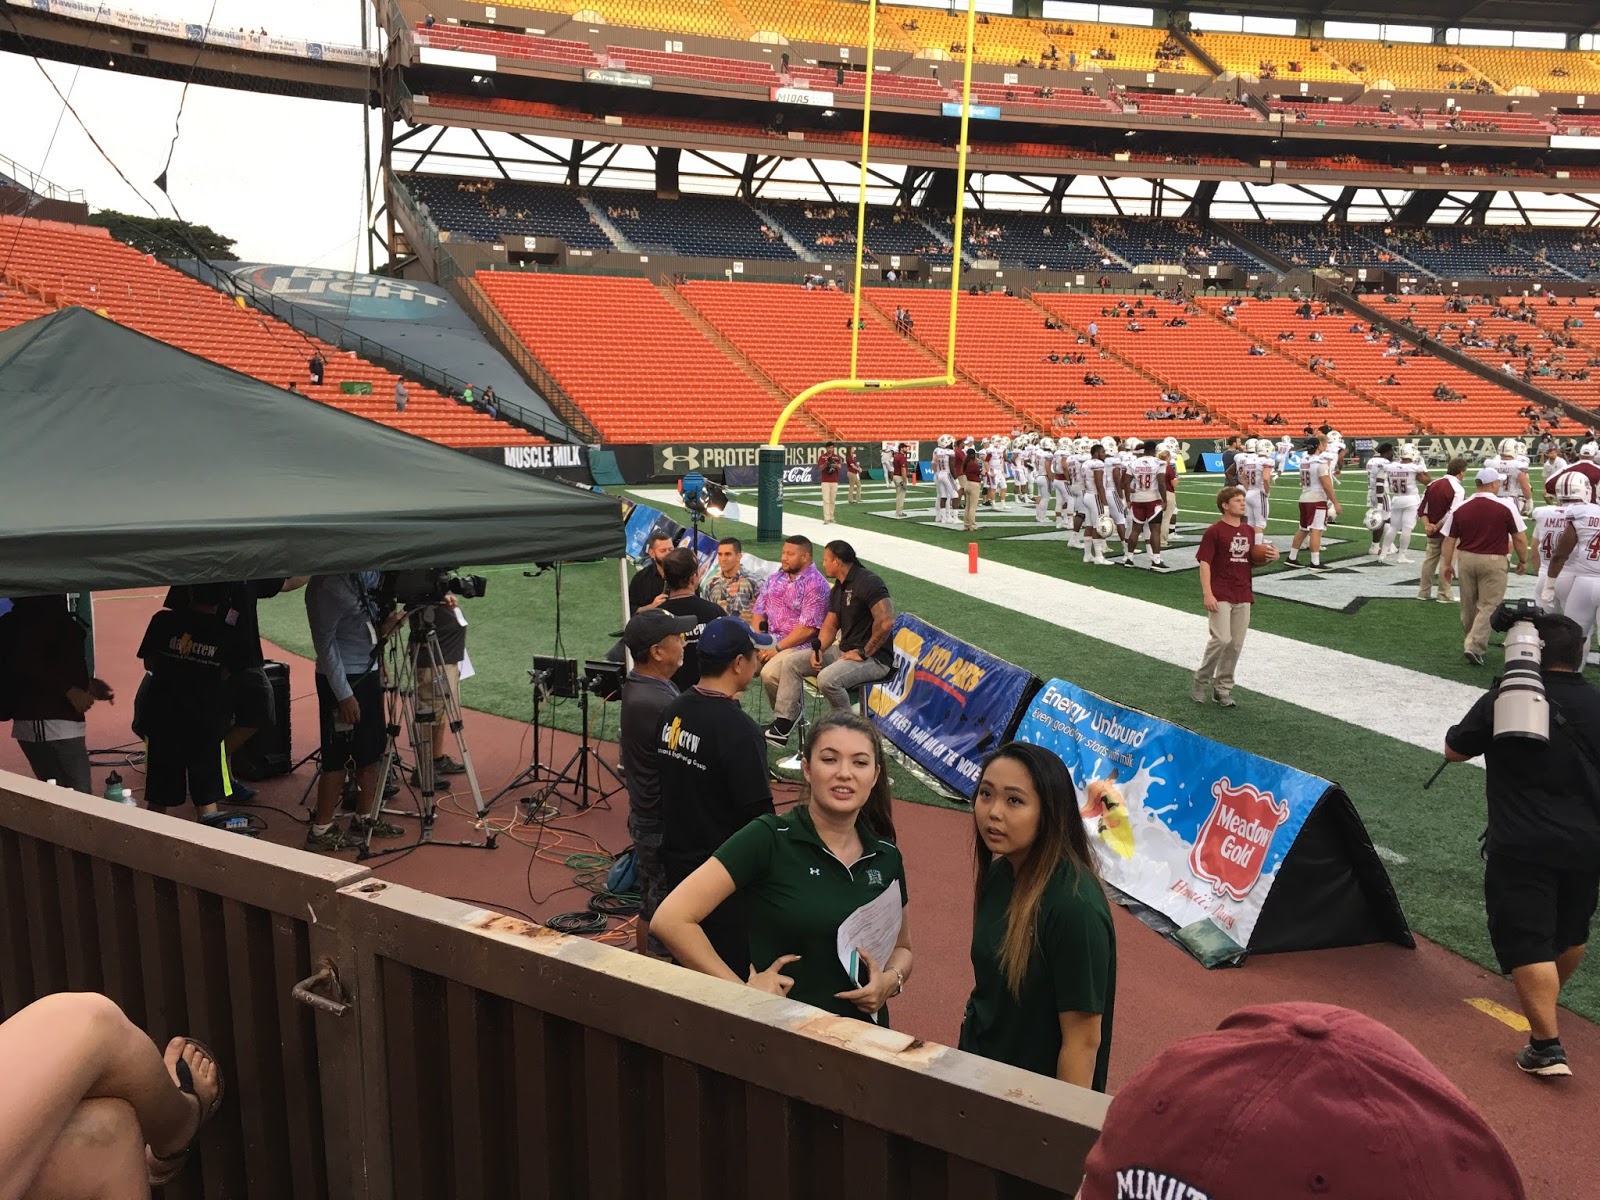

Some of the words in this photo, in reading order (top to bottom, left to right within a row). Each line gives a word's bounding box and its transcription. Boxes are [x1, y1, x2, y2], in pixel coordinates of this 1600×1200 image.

[248, 34, 260, 44] Tel
[324, 45, 364, 58] Hawaiian
[777, 93, 809, 104] MIDAS
[504, 446, 552, 468] MUSCLE
[553, 446, 581, 466] MILK
[703, 448, 759, 468] PROTE
[785, 447, 804, 466] HIS
[807, 447, 857, 466] HOS
[1137, 474, 1151, 489] 18
[1392, 480, 1408, 494] 35
[918, 644, 952, 676] AUTO
[942, 656, 986, 693] PARTS
[1041, 686, 1092, 724] Energy
[1091, 710, 1150, 748] Unbound
[1032, 707, 1054, 728] Every
[1084, 739, 1110, 757] starts
[1120, 752, 1134, 768] milk
[942, 748, 960, 767] TE
[956, 756, 982, 782] MOVE
[1216, 804, 1272, 848] Meadow
[1220, 834, 1256, 869] Gold
[1212, 902, 1236, 930] Dairy
[1116, 1169, 1210, 1200] MINUT
